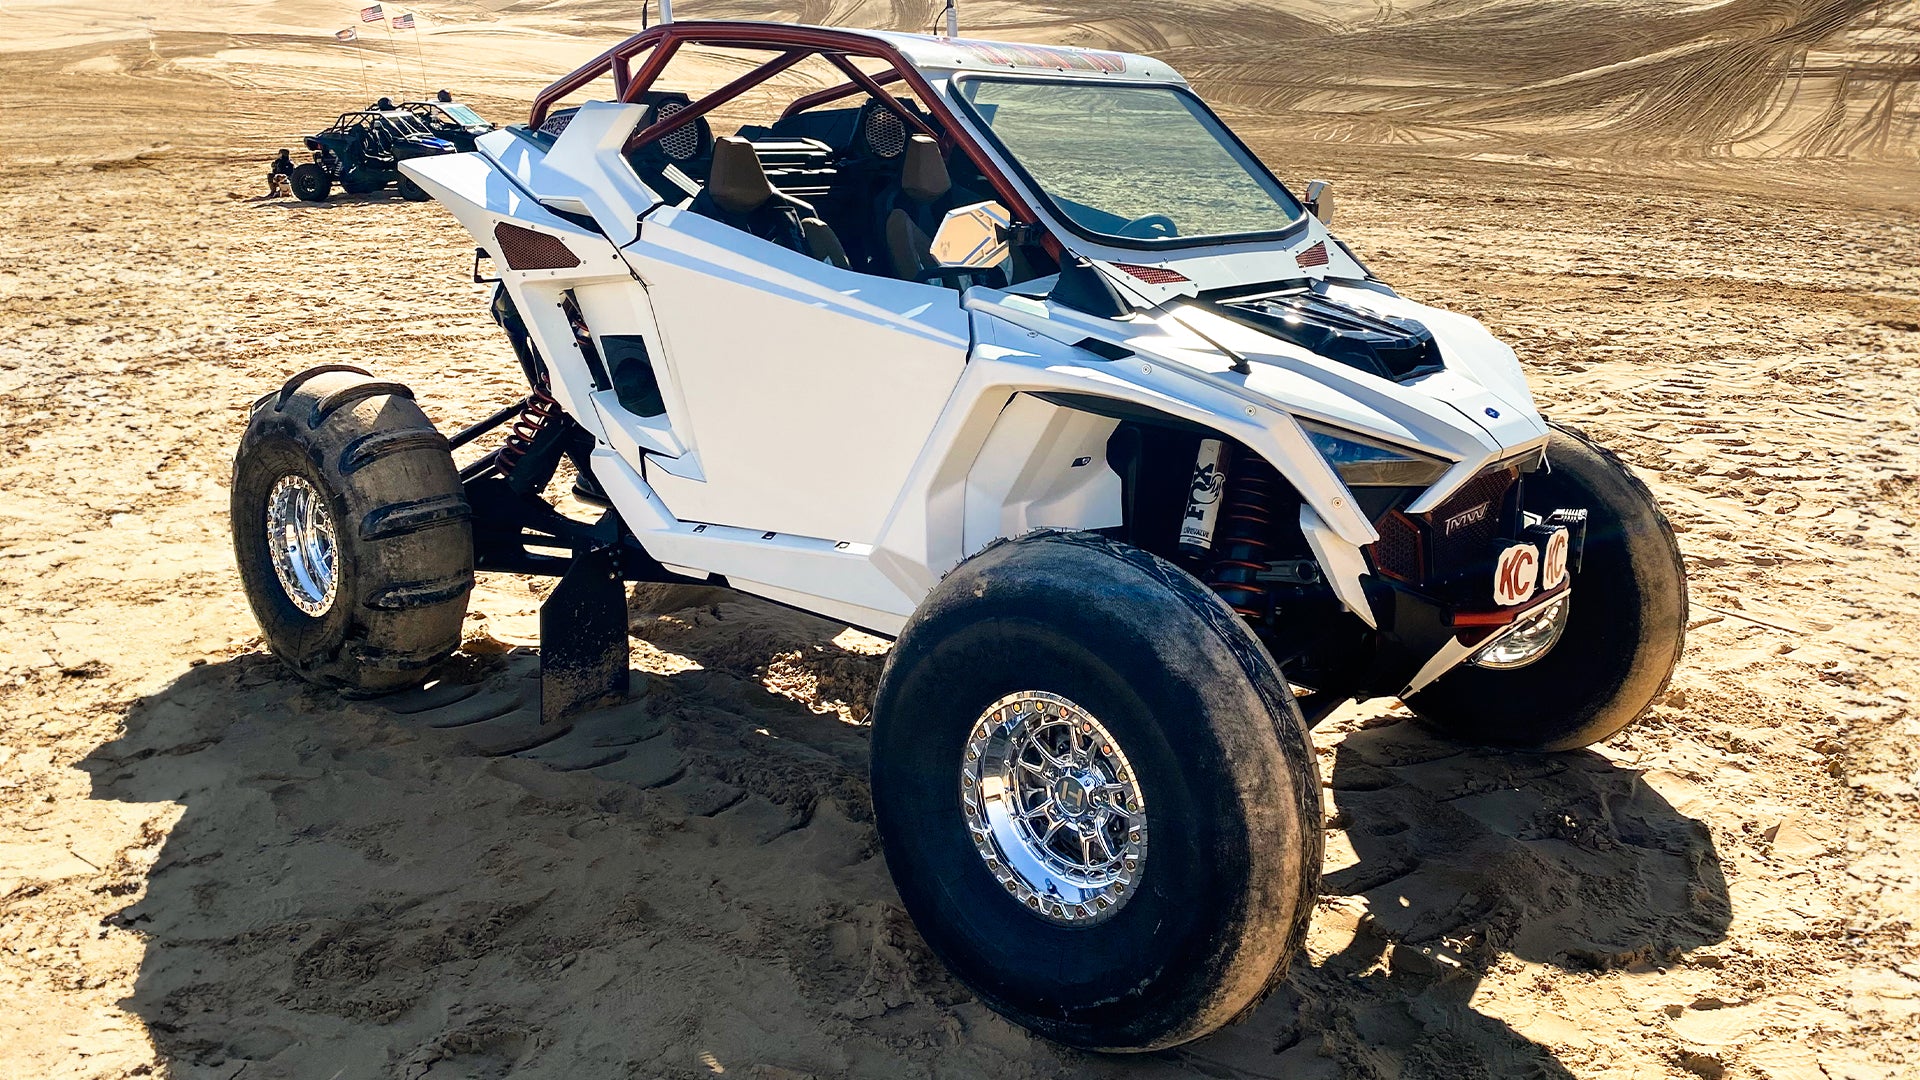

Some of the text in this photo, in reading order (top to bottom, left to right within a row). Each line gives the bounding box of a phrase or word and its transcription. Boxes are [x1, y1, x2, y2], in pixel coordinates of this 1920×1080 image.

[1183, 462, 1225, 521] FOX
[1444, 502, 1488, 537] TMW
[1499, 549, 1533, 601] KC
[1546, 534, 1565, 584] KC
